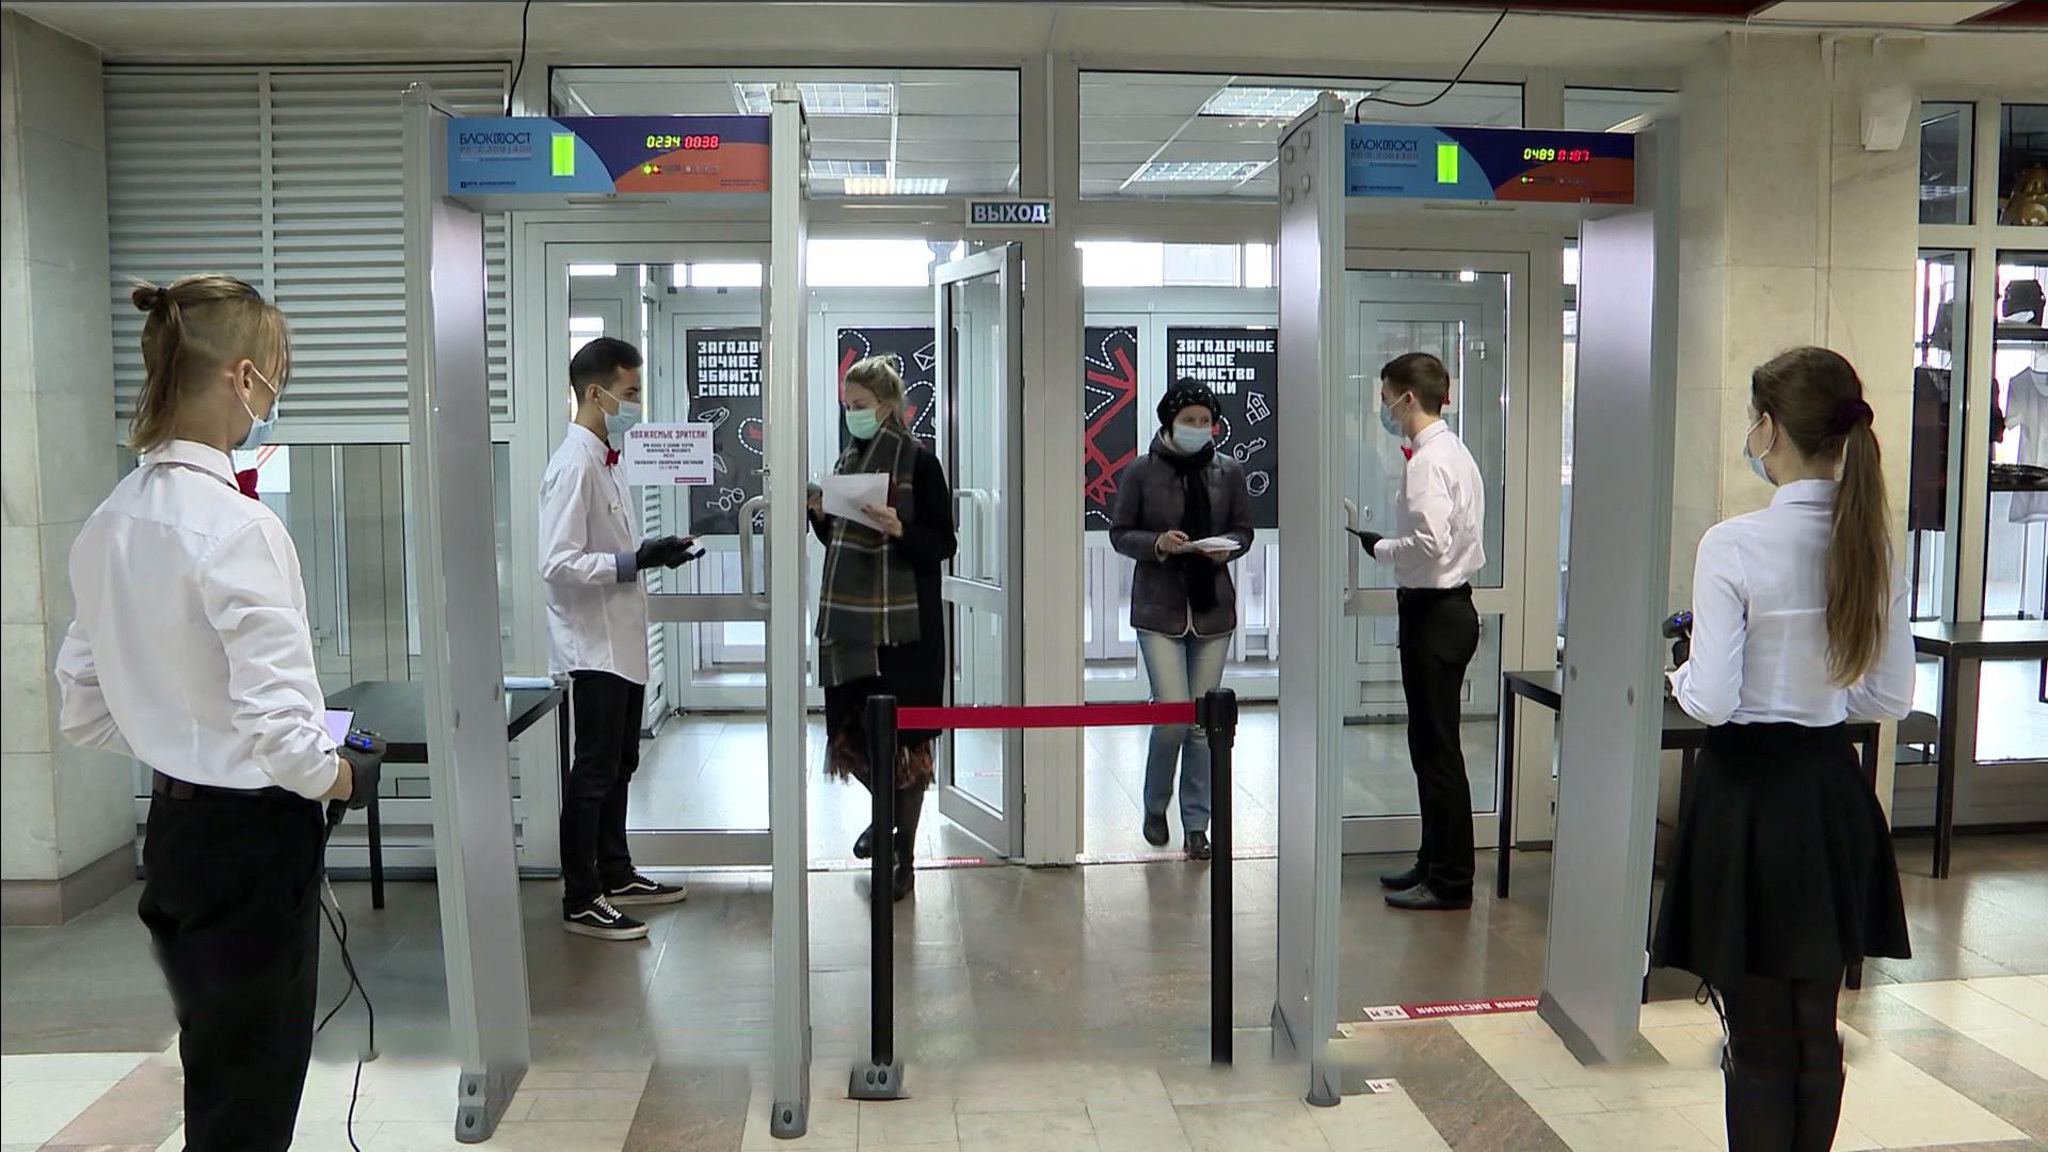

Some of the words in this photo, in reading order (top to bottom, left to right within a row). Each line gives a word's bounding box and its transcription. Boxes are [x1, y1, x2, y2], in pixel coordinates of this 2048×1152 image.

[646, 135, 681, 148] 0234
[684, 135, 719, 149] 0038
[1523, 148, 1555, 160] 0489
[974, 204, 1046, 223] ВЫХОД
[698, 341, 762, 354] ЗАГАДО
[1176, 339, 1275, 353] ЗАГАДОЧНОЕ
[698, 355, 759, 368] НОЧНОЕ
[1176, 353, 1236, 367] НОЧНОЕ
[698, 369, 762, 382] УБИЙСТ
[1176, 367, 1255, 380] УБИЙСТВО
[699, 383, 760, 396] СОБАКИ
[1207, 381, 1237, 395] АКИ
[1416, 1002, 1492, 1015] ДИСТАНЦИЯ
